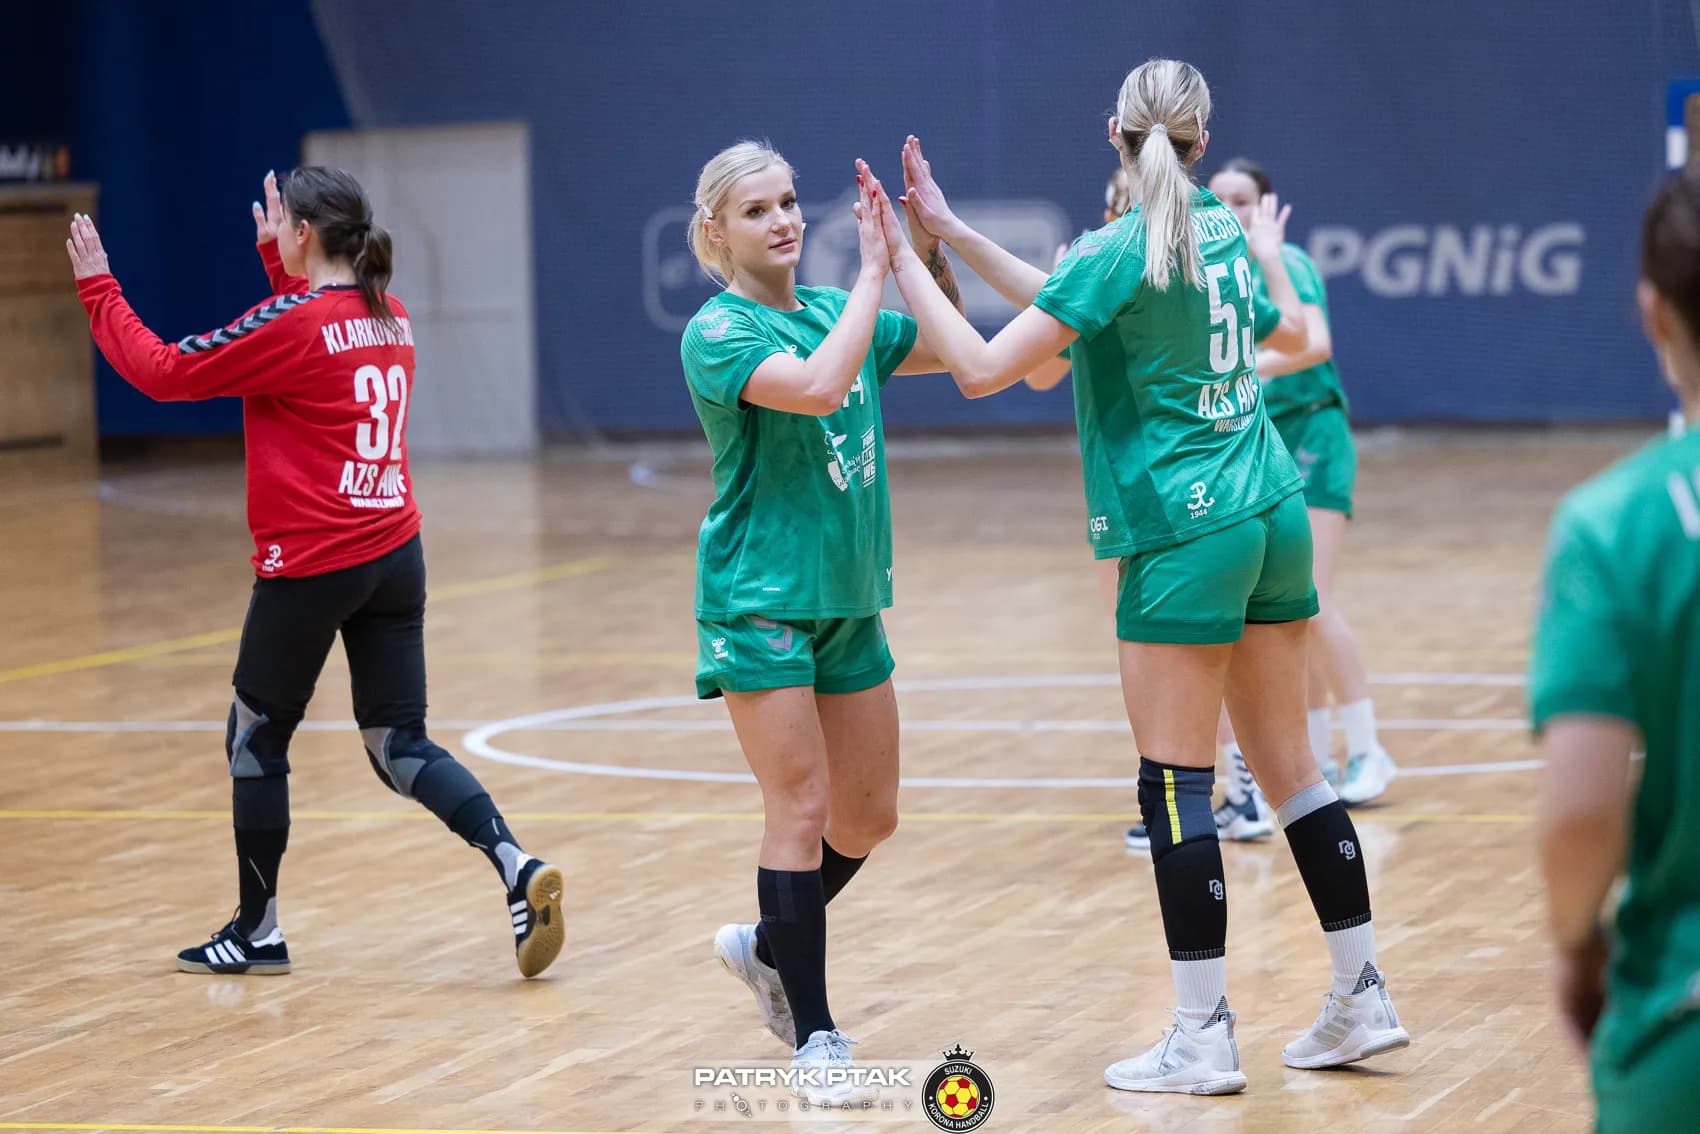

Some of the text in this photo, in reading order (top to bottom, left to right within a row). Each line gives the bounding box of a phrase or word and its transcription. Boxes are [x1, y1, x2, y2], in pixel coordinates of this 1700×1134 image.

[1307, 223, 1585, 297] PGNiG
[1204, 257, 1256, 373] 53
[354, 364, 407, 460] 32
[1198, 380, 1235, 419] AZS
[338, 460, 379, 496] AZS
